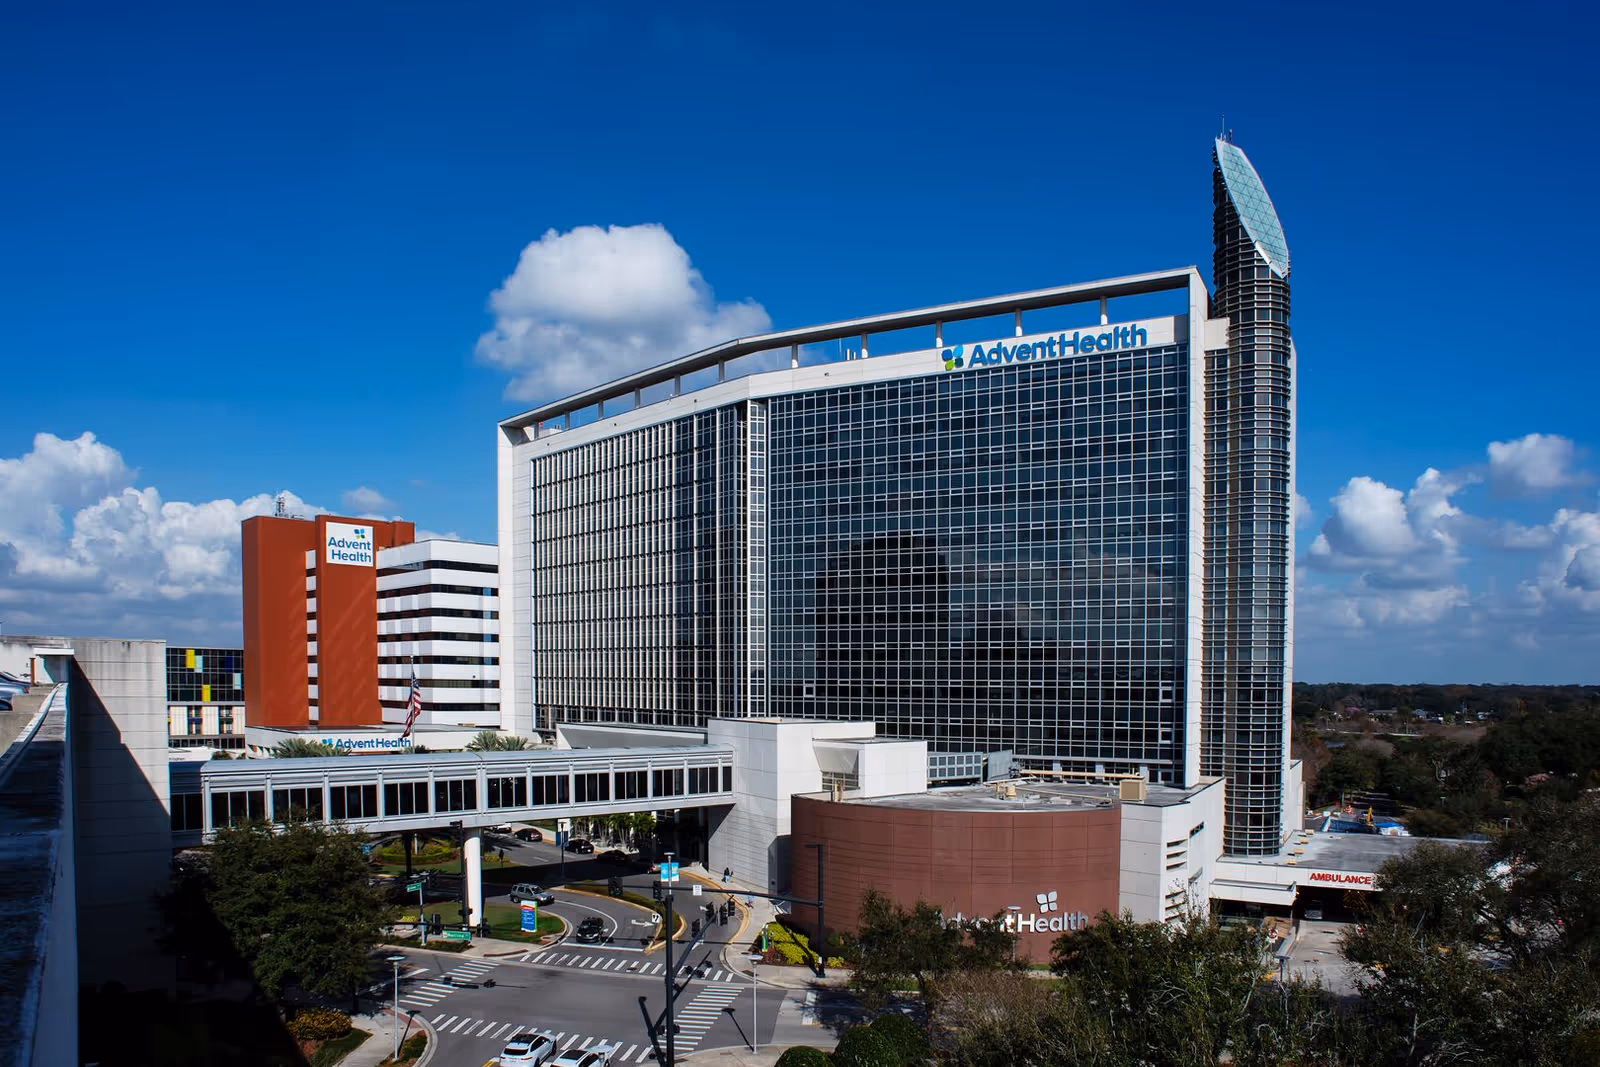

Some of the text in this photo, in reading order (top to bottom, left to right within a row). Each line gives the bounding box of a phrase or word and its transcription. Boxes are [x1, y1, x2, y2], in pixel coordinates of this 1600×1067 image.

[968, 324, 1148, 368] AdventHealth
[328, 537, 371, 550] Advent
[331, 549, 371, 562] Health
[1310, 872, 1371, 884] AMBULANCE
[935, 911, 1089, 933] detHealth
